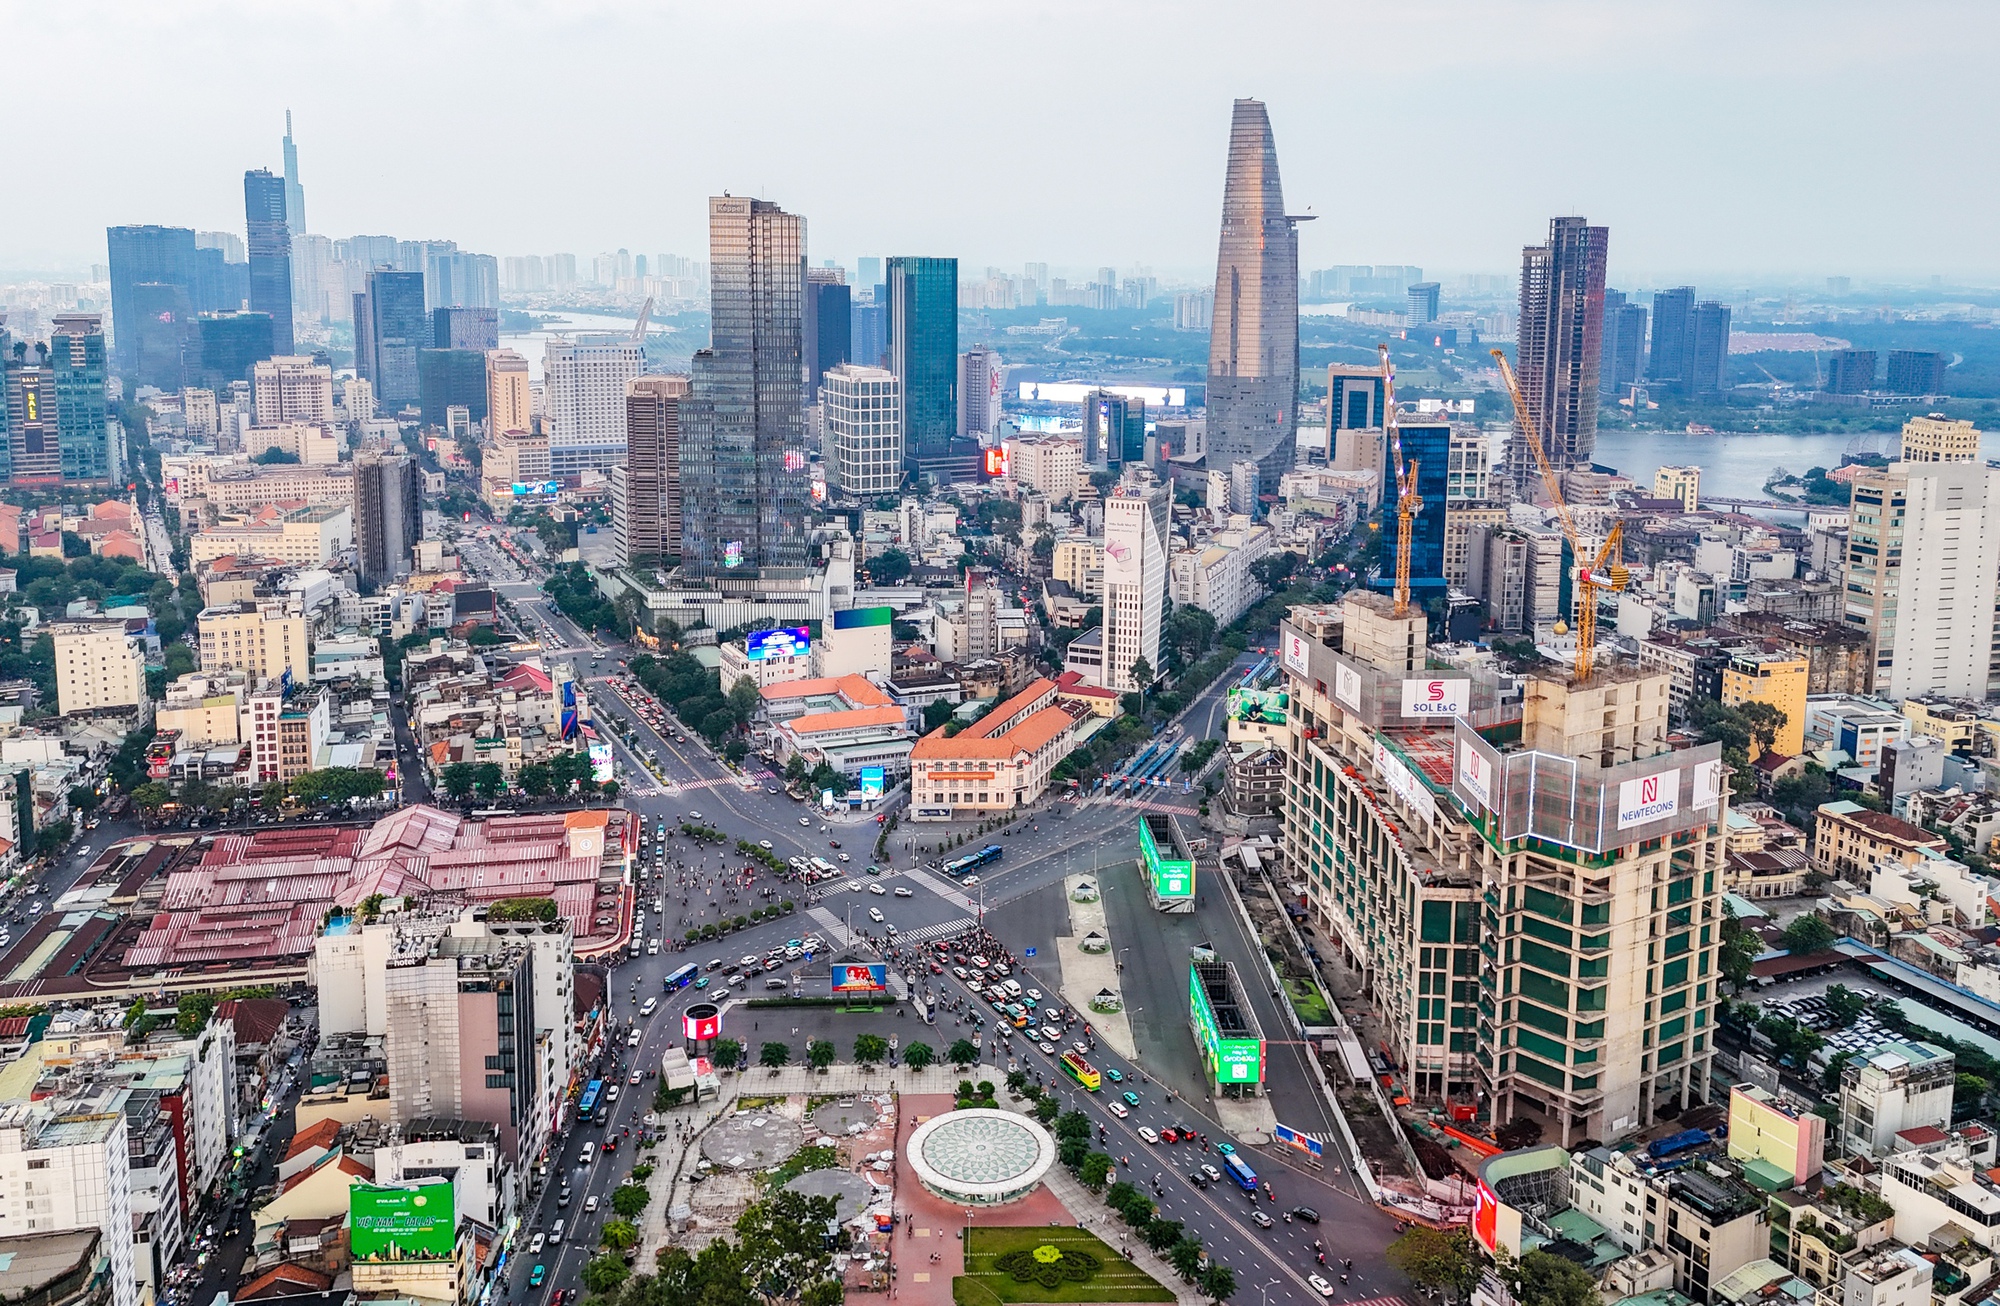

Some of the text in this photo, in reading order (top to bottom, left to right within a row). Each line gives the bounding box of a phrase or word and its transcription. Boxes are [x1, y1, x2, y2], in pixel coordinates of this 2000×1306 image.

[717, 205, 744, 213] Keppel
[27, 392, 37, 420] SALE
[1125, 489, 1141, 497] MB
[1413, 703, 1457, 712] SOL E&C
[1621, 800, 1674, 822] NEWTECONS
[394, 958, 415, 967] hotel
[356, 1215, 436, 1228] VIỆT NAM DALLAS
